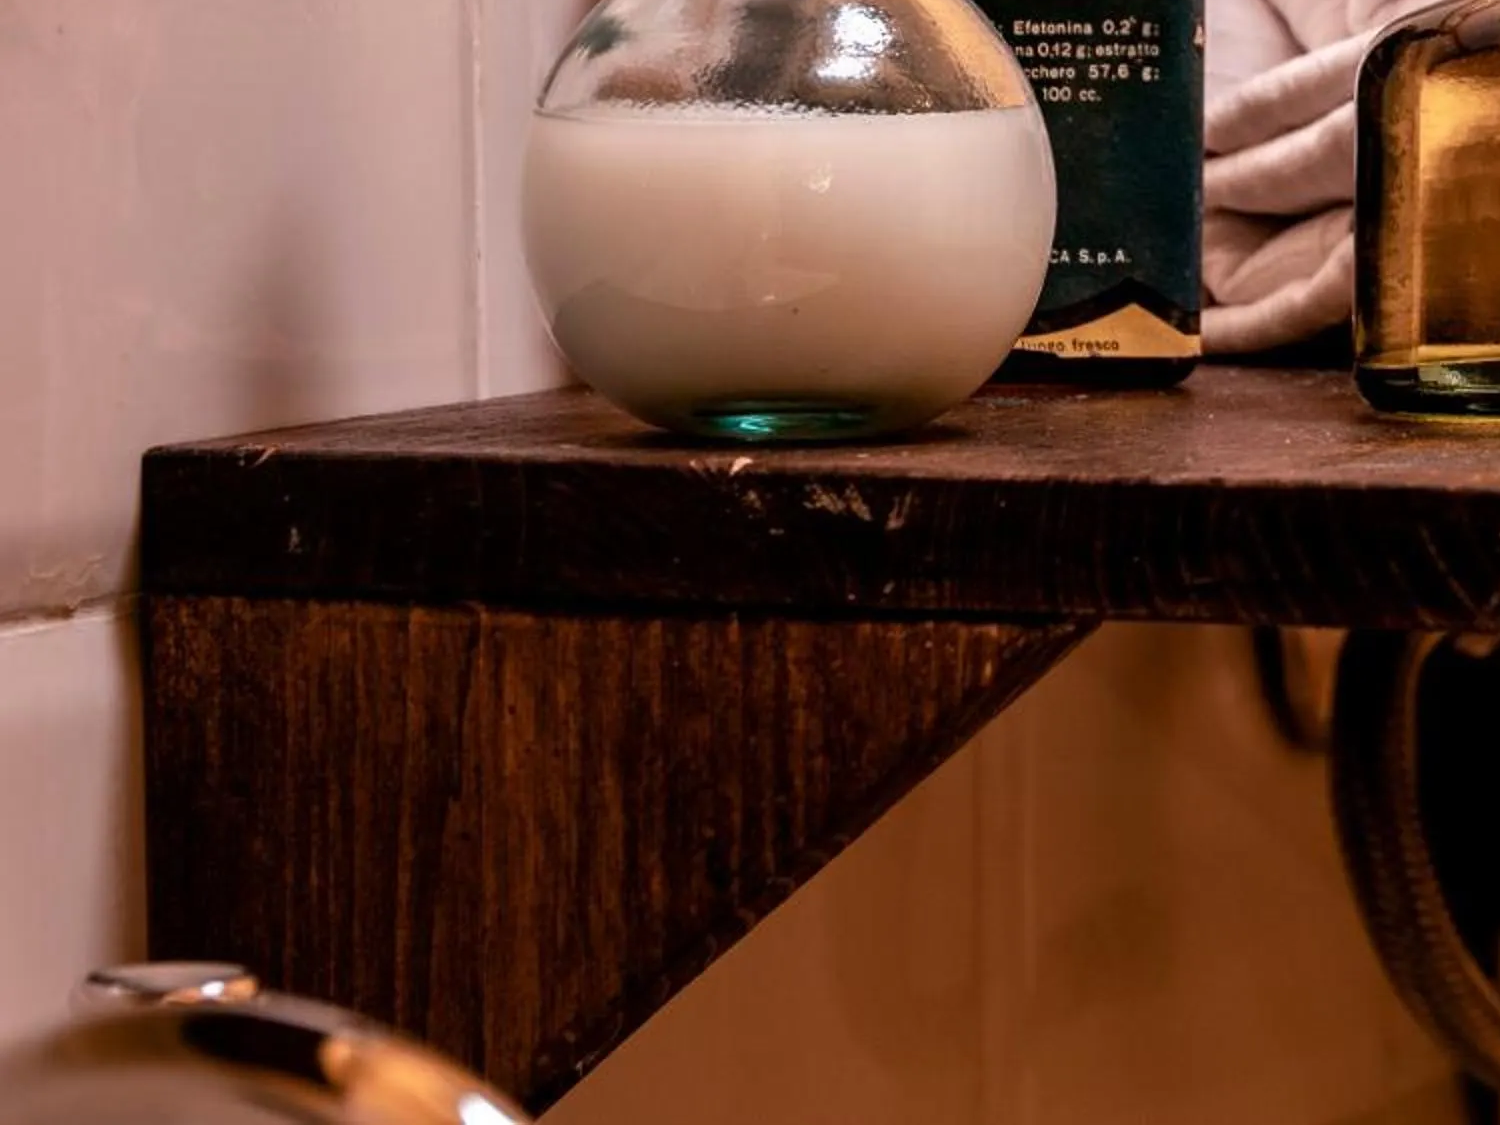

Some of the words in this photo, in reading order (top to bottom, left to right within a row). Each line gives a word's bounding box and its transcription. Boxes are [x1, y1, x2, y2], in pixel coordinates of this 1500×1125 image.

[1013, 19, 1093, 36] Efetonina
[1095, 42, 1160, 58] estratto
[1042, 87, 1071, 102] 100
[1079, 89, 1102, 102] cc.
